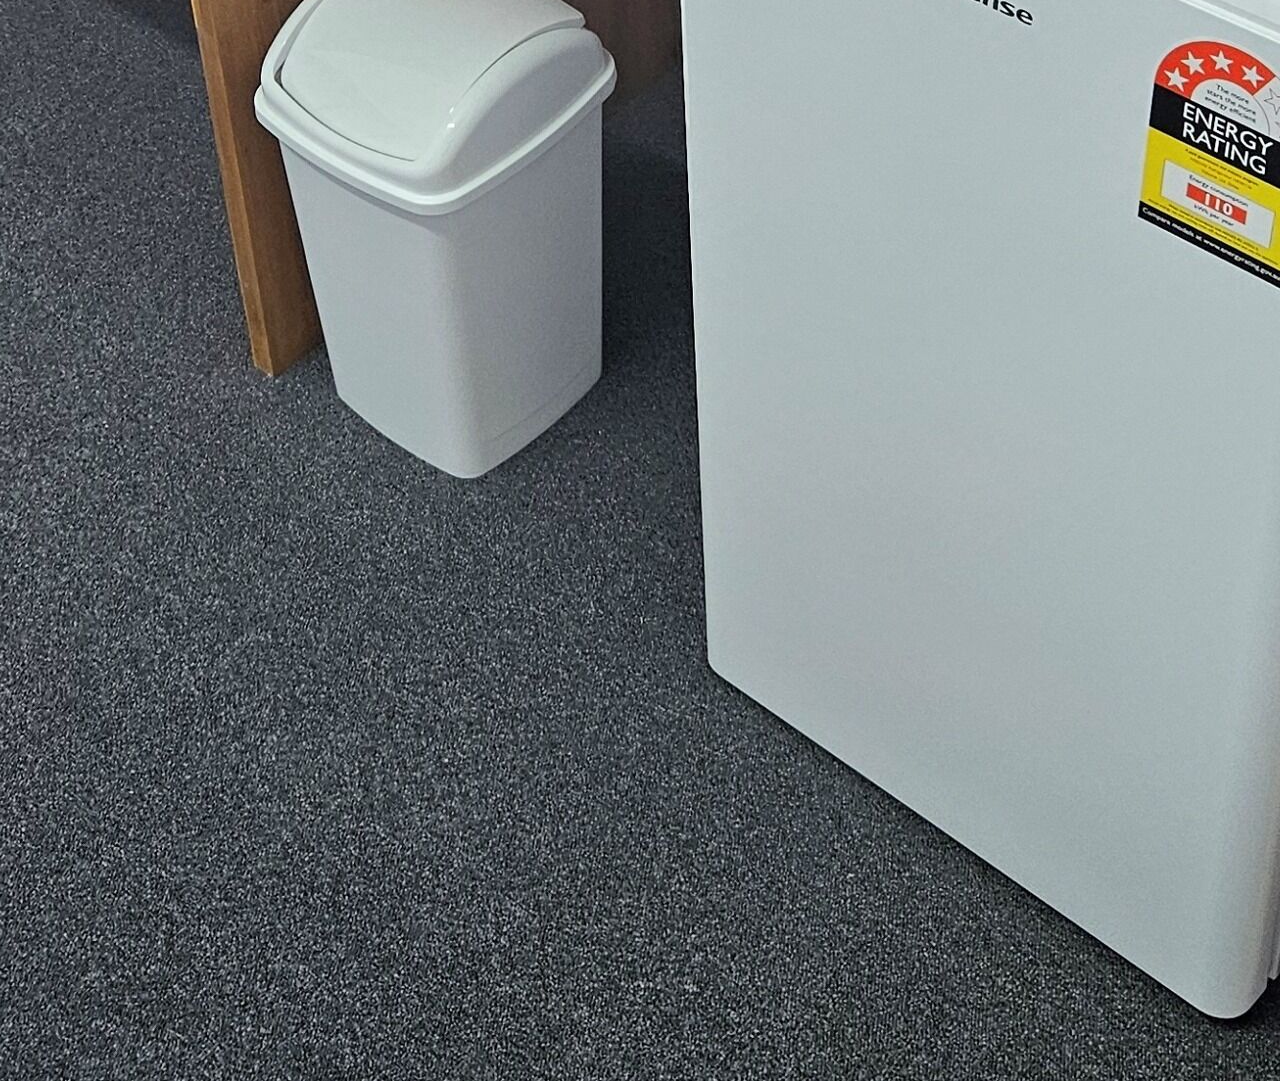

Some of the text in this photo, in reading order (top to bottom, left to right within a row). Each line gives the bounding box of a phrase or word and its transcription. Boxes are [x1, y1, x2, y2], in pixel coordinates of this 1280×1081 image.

[1206, 89, 1256, 115] stars the more
[1217, 84, 1248, 104] The more
[1204, 96, 1255, 122] energy efficient
[1182, 101, 1273, 155] ENERGY
[1182, 121, 1266, 174] RATING
[1189, 174, 1208, 188] Energy
[1210, 186, 1248, 206] consumption
[1204, 192, 1232, 215] 110
[1142, 206, 1170, 225] Compare
[1171, 222, 1194, 236] models
[1208, 212, 1219, 220] per
[1220, 218, 1234, 226] year
